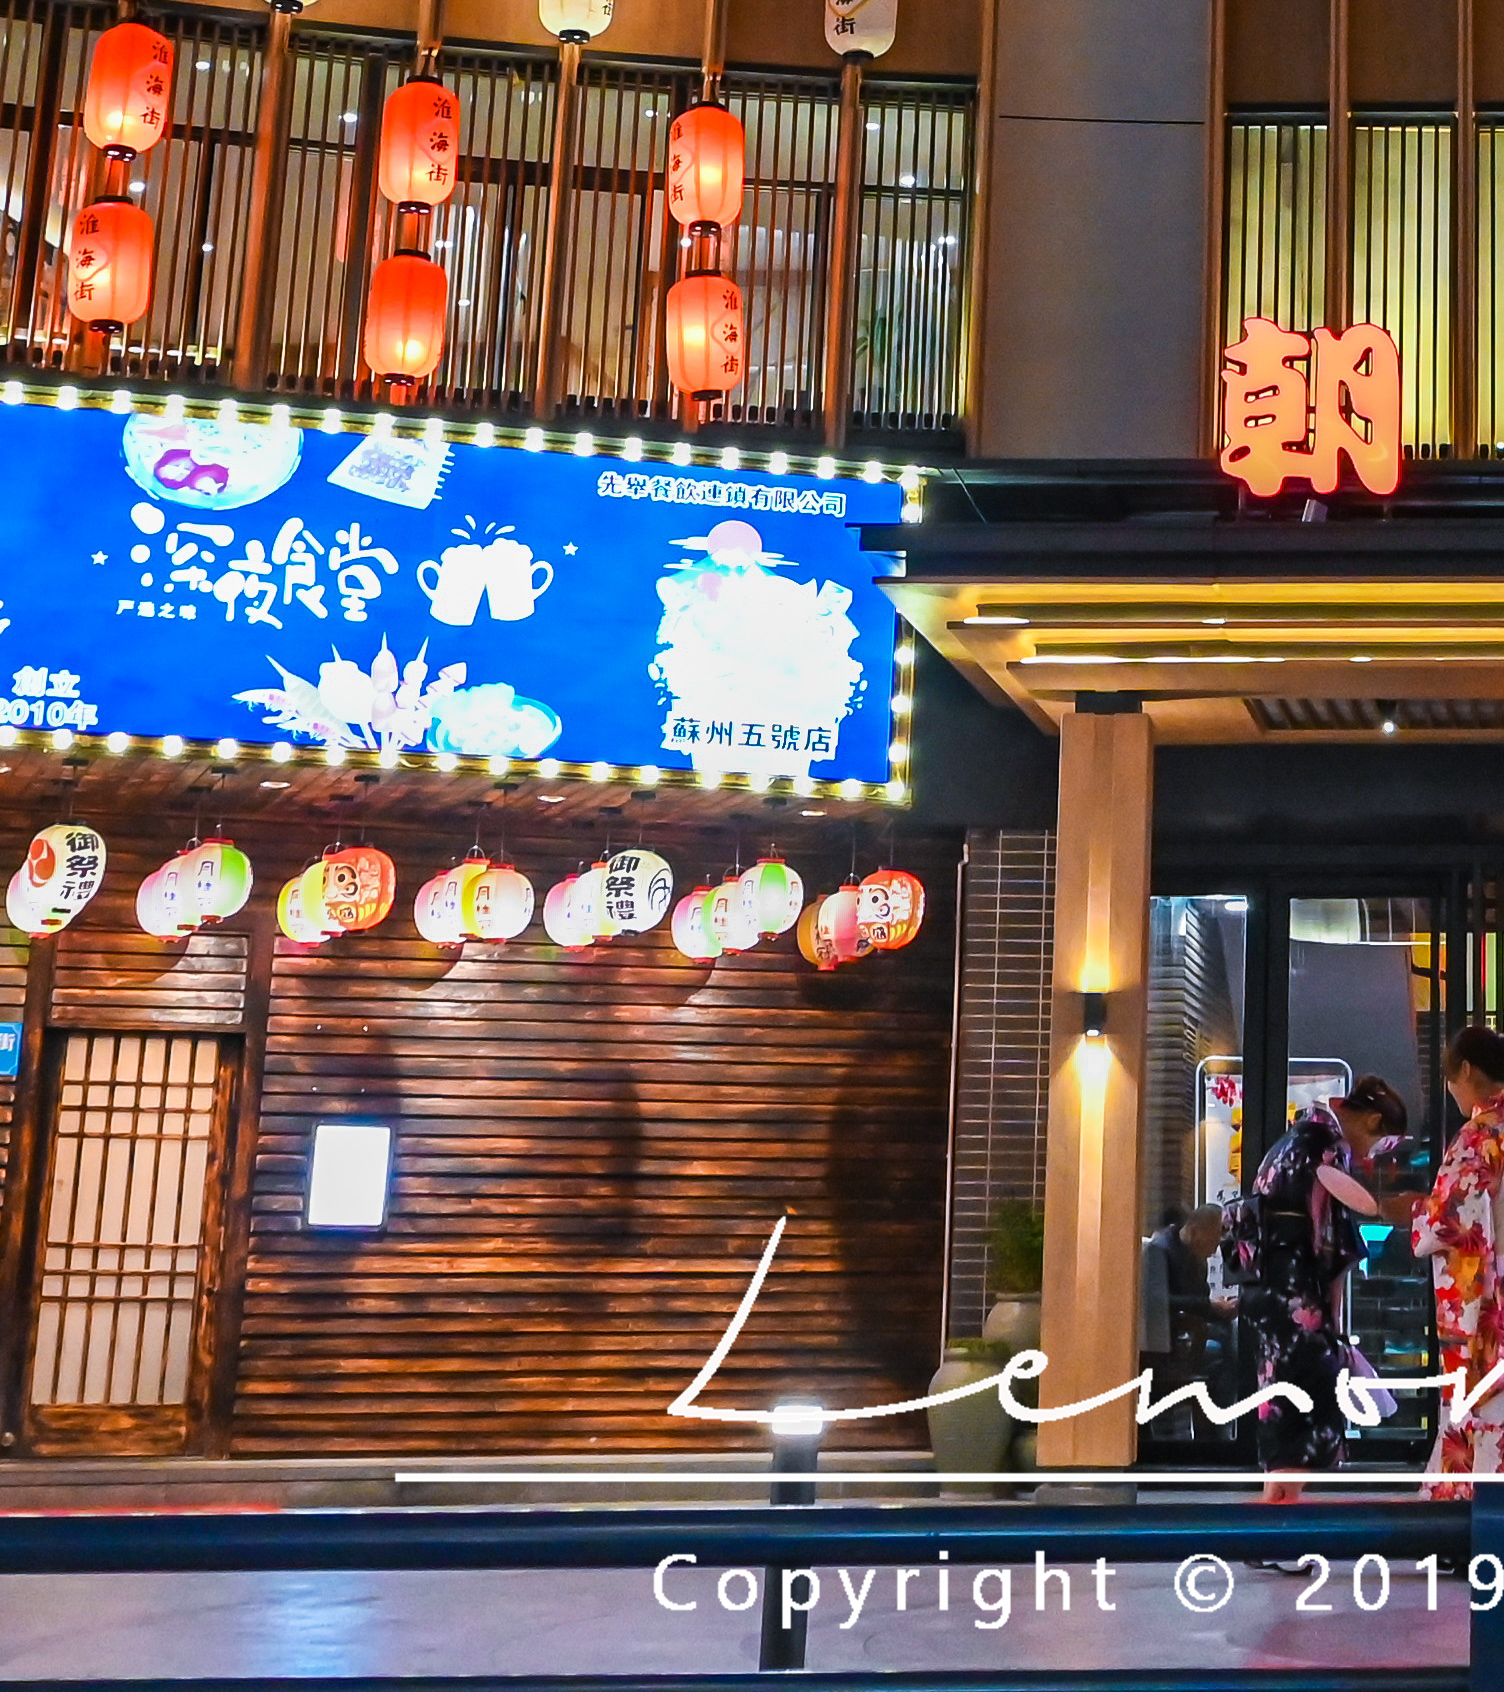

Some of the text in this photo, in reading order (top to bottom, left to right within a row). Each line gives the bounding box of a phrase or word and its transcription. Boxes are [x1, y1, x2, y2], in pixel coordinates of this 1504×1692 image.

[426, 95, 453, 186] 淮海街
[72, 213, 99, 303] 淮海街
[130, 501, 399, 630] 深夜食堂
